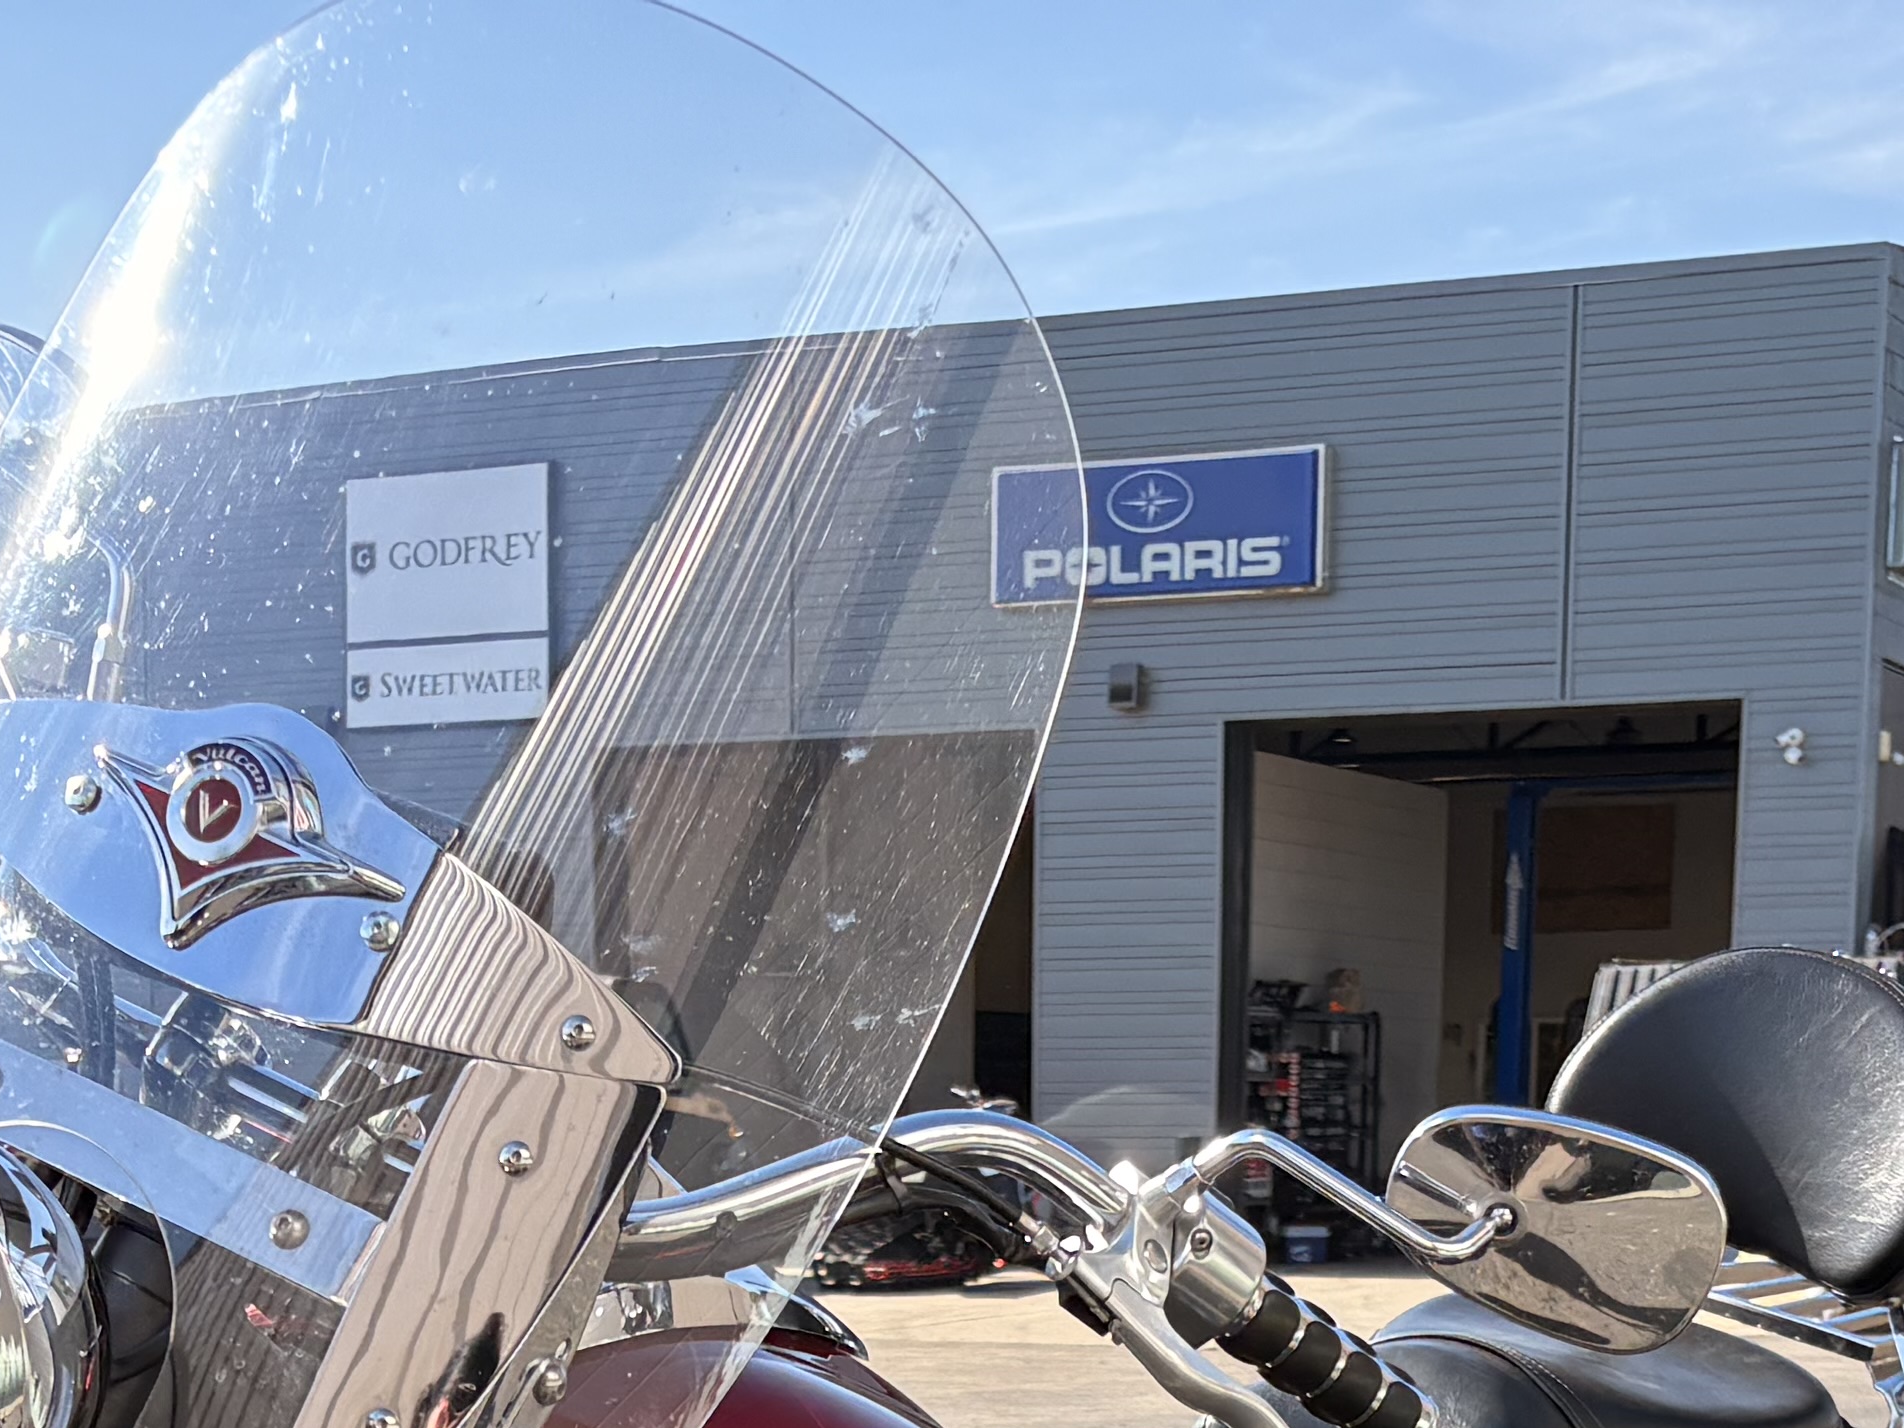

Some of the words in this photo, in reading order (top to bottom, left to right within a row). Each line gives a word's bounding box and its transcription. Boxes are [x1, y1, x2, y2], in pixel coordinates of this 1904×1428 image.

[388, 530, 542, 570] GODFREY
[1022, 536, 1282, 589] POLARIS
[379, 667, 543, 698] SWEETWATER
